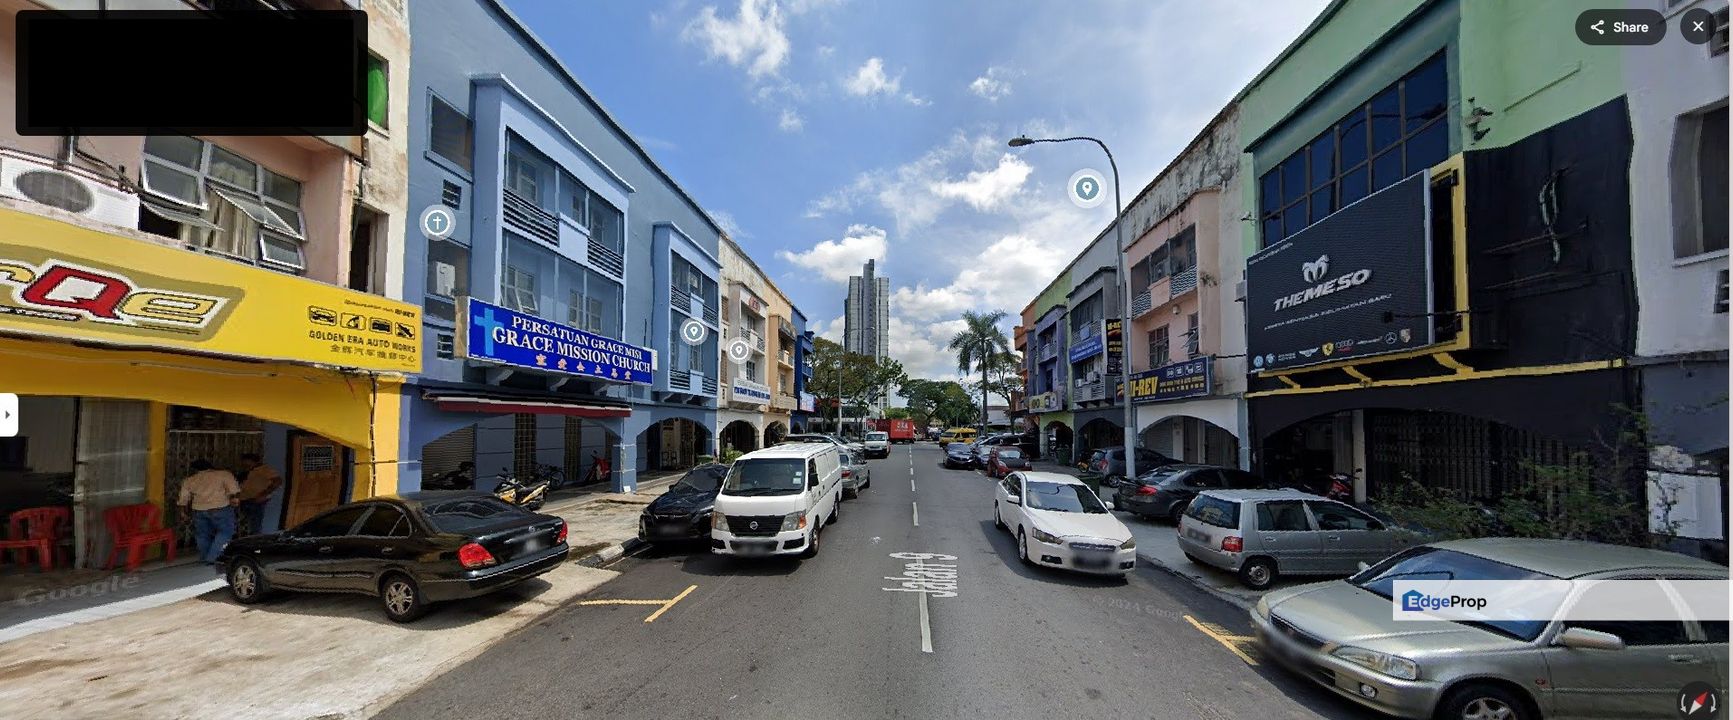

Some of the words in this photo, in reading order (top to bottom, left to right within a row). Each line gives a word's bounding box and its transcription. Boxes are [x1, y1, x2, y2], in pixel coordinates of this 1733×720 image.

[1273, 269, 1373, 312] THEMESO
[309, 330, 344, 342] GOLDEN
[347, 334, 364, 345] ERA
[366, 338, 390, 348] AUTO
[392, 342, 416, 353] WORKS
[493, 327, 554, 353] GRACE
[557, 342, 611, 365] MISSION
[612, 353, 650, 373] CHURCH
[512, 315, 588, 346] PERSATUAN
[591, 337, 624, 354] GRACE
[625, 347, 643, 360] MISI
[882, 562, 958, 597] Jalan
